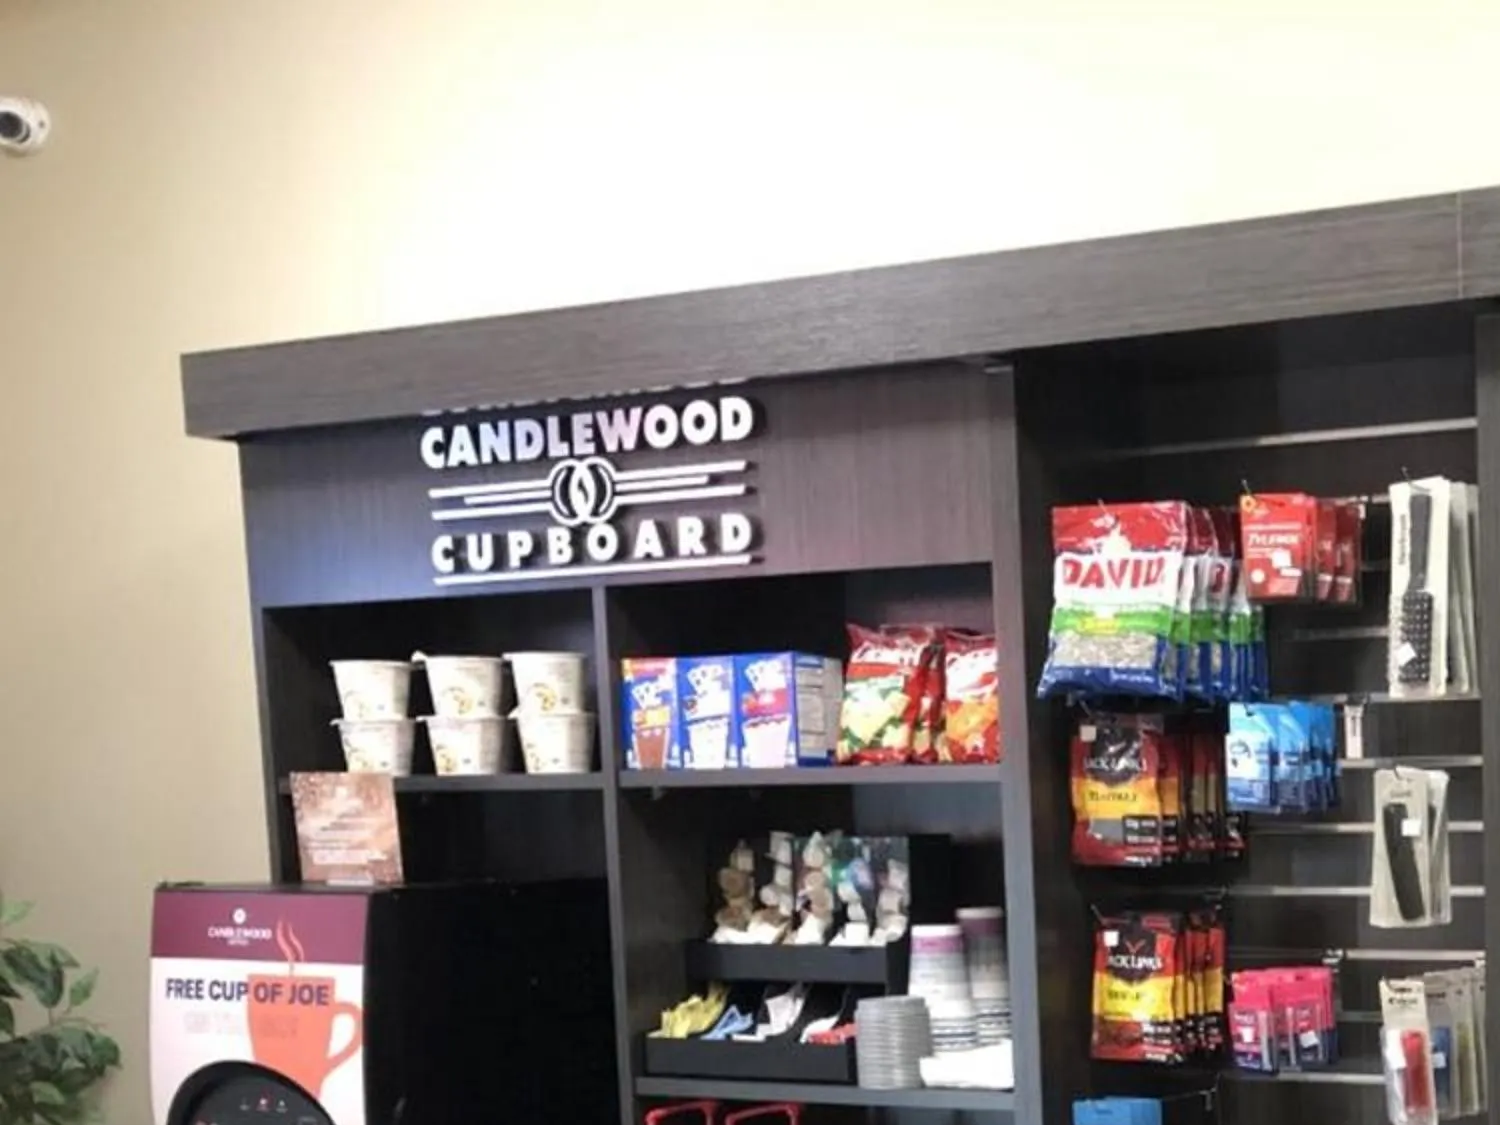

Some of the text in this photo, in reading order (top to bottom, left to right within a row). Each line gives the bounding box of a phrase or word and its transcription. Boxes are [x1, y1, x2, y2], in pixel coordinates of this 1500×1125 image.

[420, 396, 755, 468] CANDLEWOOD
[431, 512, 754, 572] CUPBOARD
[1062, 557, 1167, 589] DAVID
[165, 977, 330, 1006] FREE CUP OF JOE
